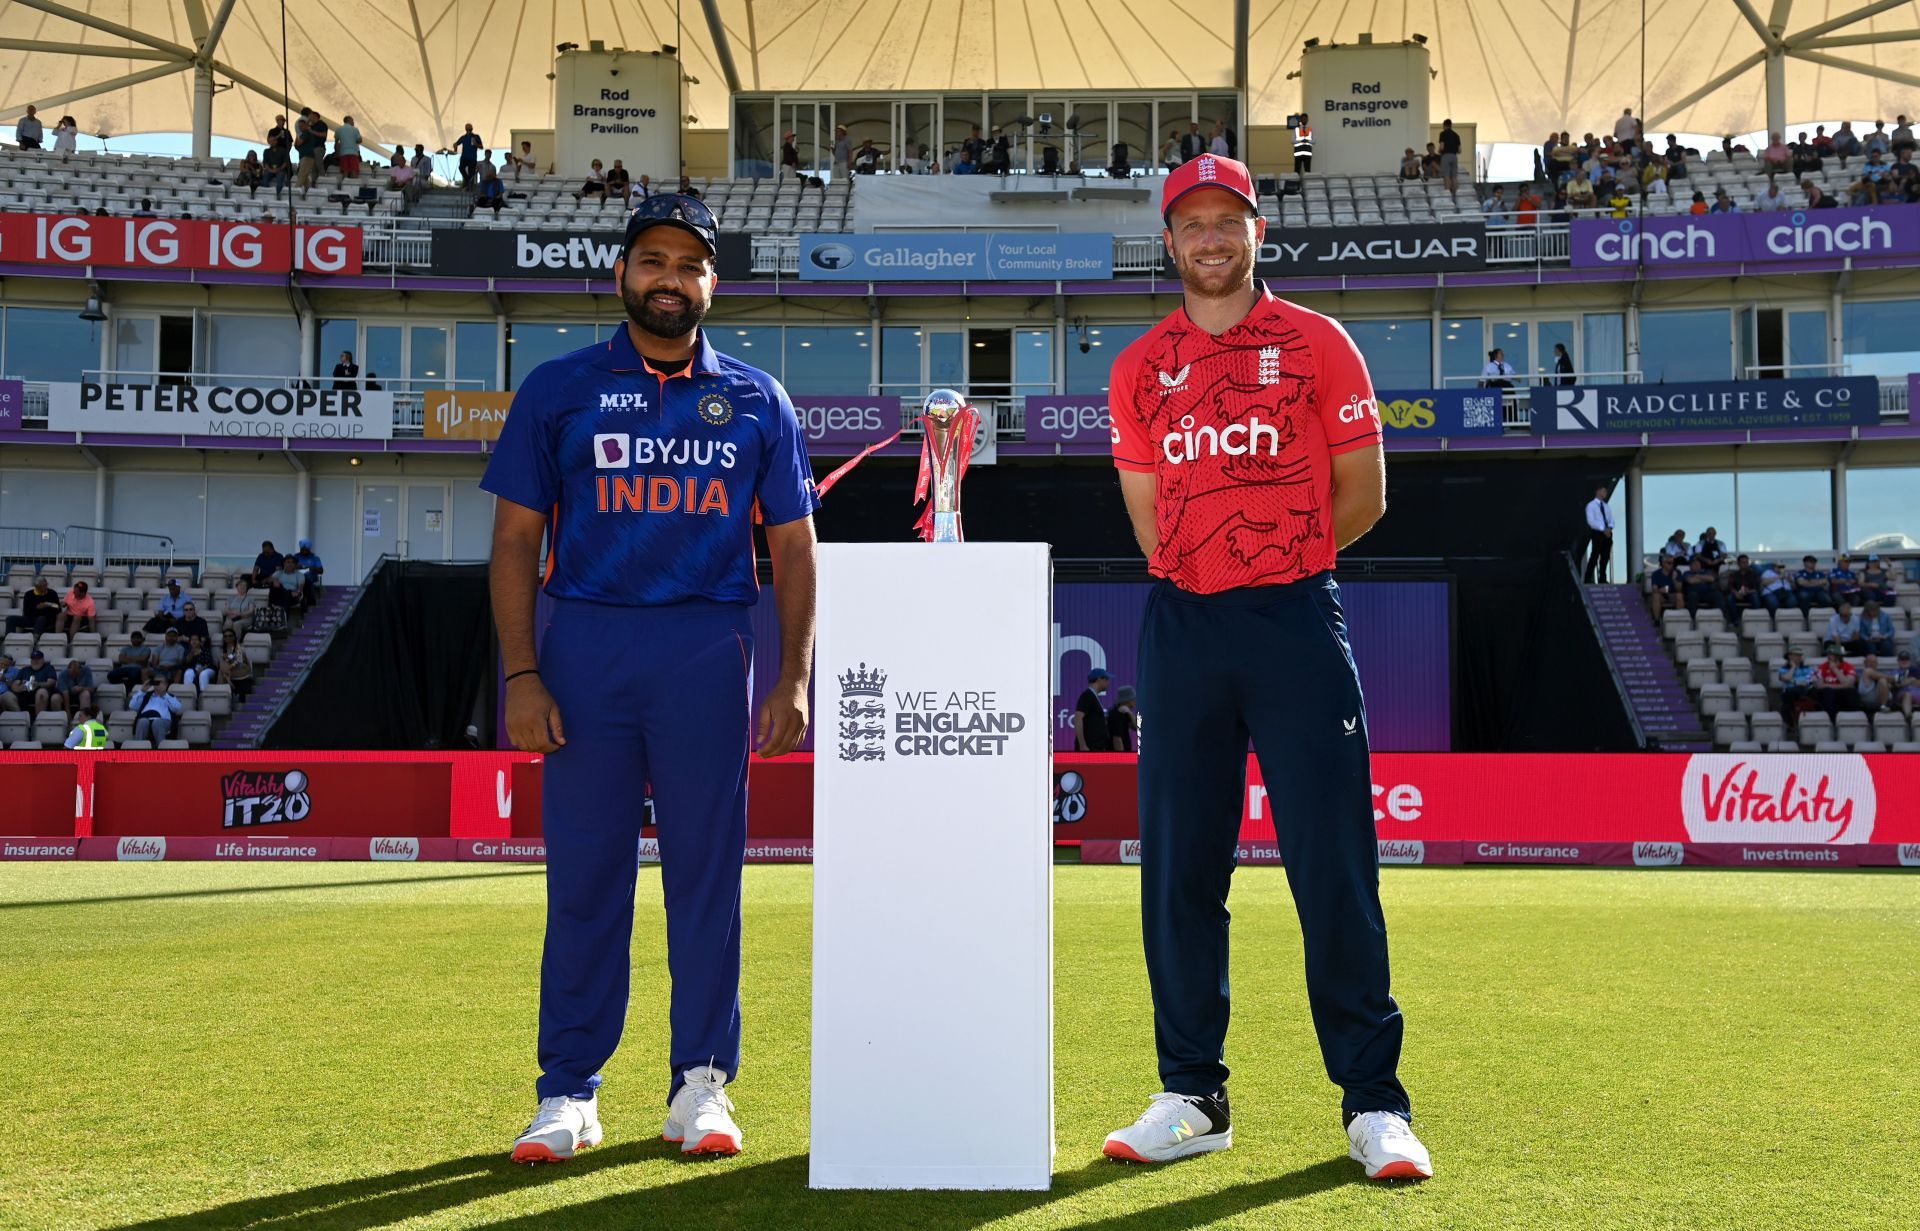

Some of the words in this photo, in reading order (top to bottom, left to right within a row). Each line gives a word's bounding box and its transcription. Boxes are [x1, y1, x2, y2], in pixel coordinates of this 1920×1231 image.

[600, 88, 630, 101] Rod
[1351, 82, 1381, 94] Rod
[573, 104, 656, 119] Bransgrove
[1324, 98, 1409, 113] Bransgrove
[591, 123, 639, 134] Pavilion
[1342, 116, 1391, 128] Pavilion
[36, 217, 92, 262] IG
[124, 221, 179, 265] IG
[1595, 220, 1716, 262] cinch
[1766, 212, 1892, 255] cinch
[209, 224, 262, 268] IG
[294, 228, 347, 272] IG
[516, 234, 624, 269] betw
[998, 244, 1024, 255] Your
[1026, 244, 1056, 255] Local
[1256, 242, 1310, 263] DY
[1317, 237, 1479, 261] JAGUAR
[864, 247, 977, 270] Gallagher
[998, 258, 1063, 271] Community
[1065, 257, 1103, 269] Broker
[79, 383, 199, 413] PETER
[207, 386, 364, 417] COOPER
[600, 393, 648, 407] MPL
[1339, 394, 1378, 423] cin
[1605, 391, 1768, 415] RADCLIFFE
[1782, 390, 1803, 409] &
[469, 408, 508, 422] PAN
[793, 406, 882, 439] ageas
[1040, 406, 1110, 439] agea
[1681, 416, 1735, 426] FINANCIAL
[208, 420, 284, 438] MOTOR
[292, 422, 364, 439] GROUP
[1162, 414, 1279, 464] cinch
[635, 437, 738, 469] BYJU'S
[595, 474, 730, 517] INDIA
[895, 691, 938, 711] WE
[944, 691, 996, 711] ARE
[895, 712, 1026, 733] ENGLAND
[894, 735, 1009, 756] CRICKET
[224, 772, 284, 797] Vitality
[224, 792, 310, 826] IT20
[1702, 761, 1854, 842] Vitality
[4, 843, 75, 856] insurance
[122, 839, 161, 859] Vitality
[215, 843, 244, 856] Life
[247, 843, 317, 856] insurance
[374, 839, 414, 859] Vitality
[472, 842, 498, 855] Car
[501, 842, 547, 856] insura
[1380, 841, 1419, 862] Vitality
[1477, 843, 1505, 856] Car
[1507, 843, 1579, 858] insurance
[1637, 844, 1680, 863] Vitality
[1743, 847, 1839, 861] Investments
